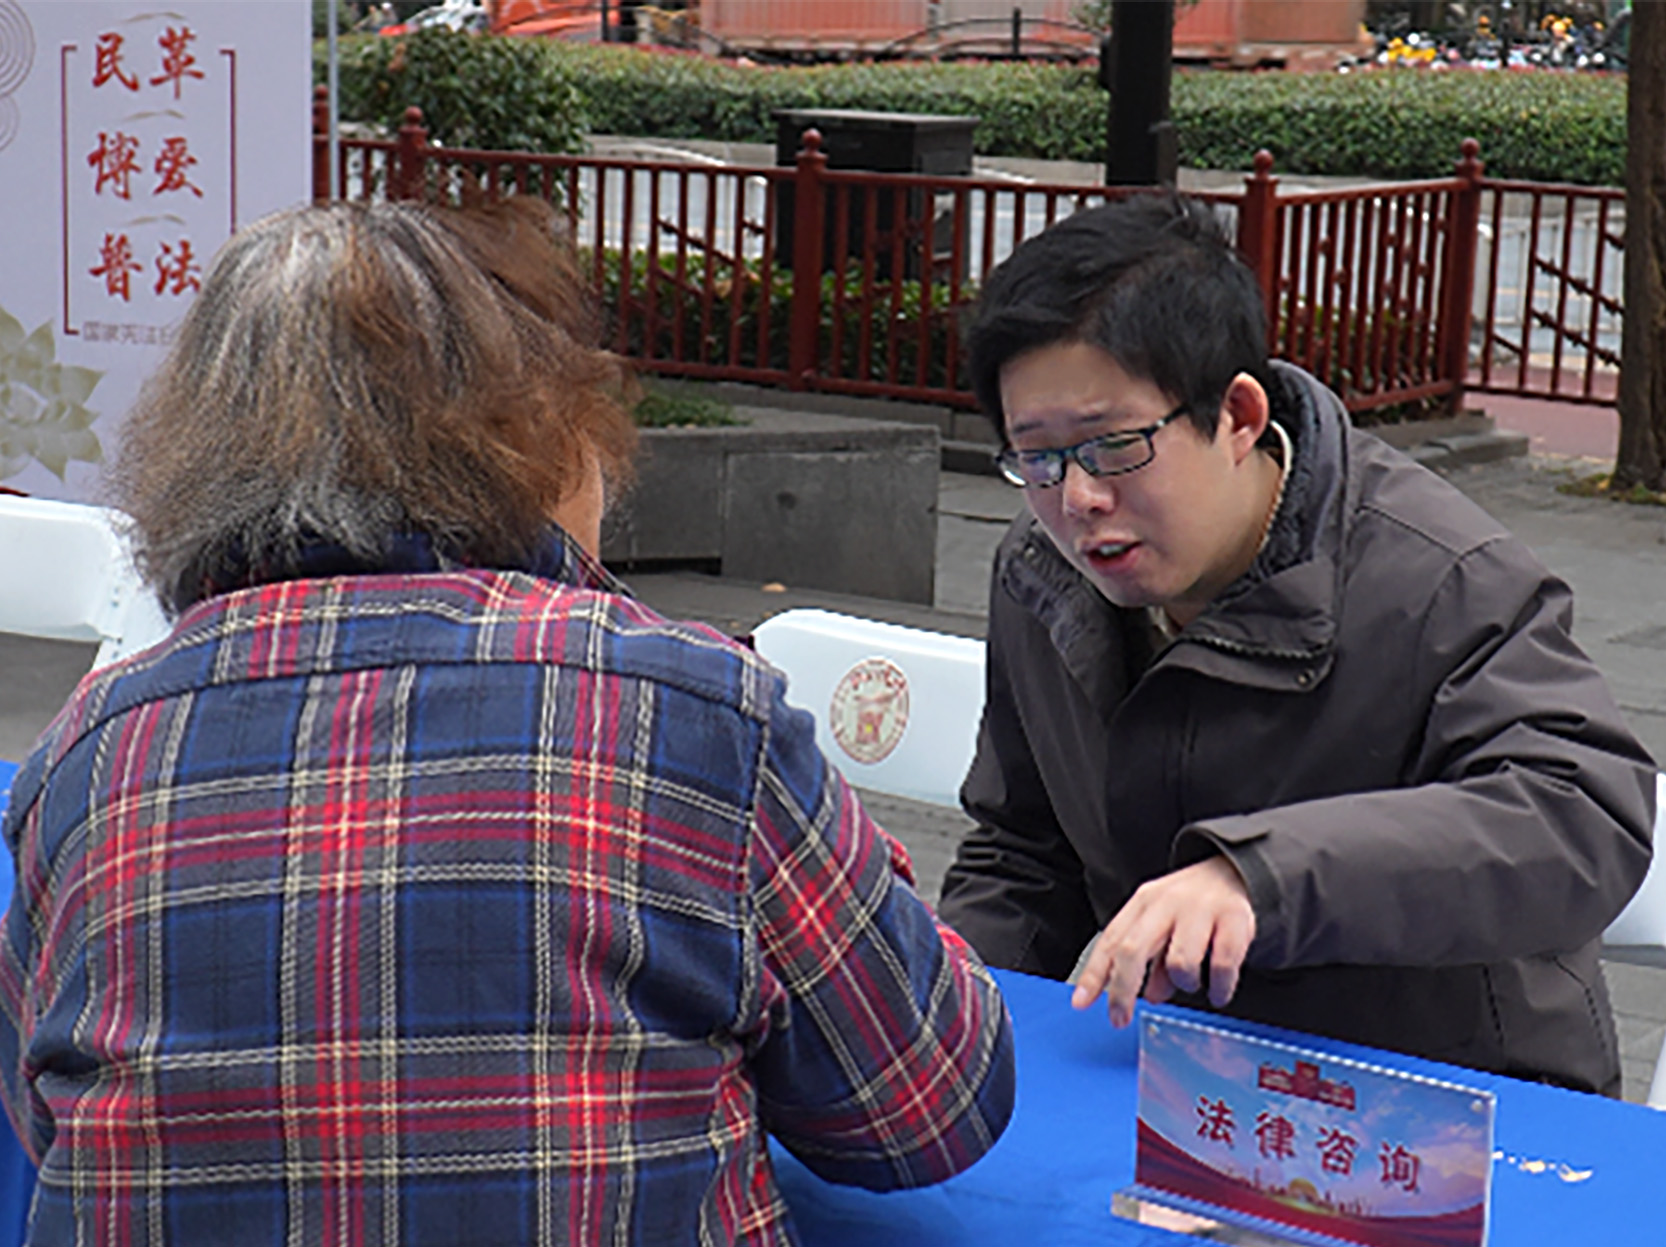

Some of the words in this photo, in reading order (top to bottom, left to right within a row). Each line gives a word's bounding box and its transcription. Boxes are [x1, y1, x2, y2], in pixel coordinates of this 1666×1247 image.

[93, 27, 204, 100] 民革
[87, 132, 203, 200] 博爱
[89, 234, 200, 302] 普法
[1196, 1095, 1421, 1192] 法律咨询
